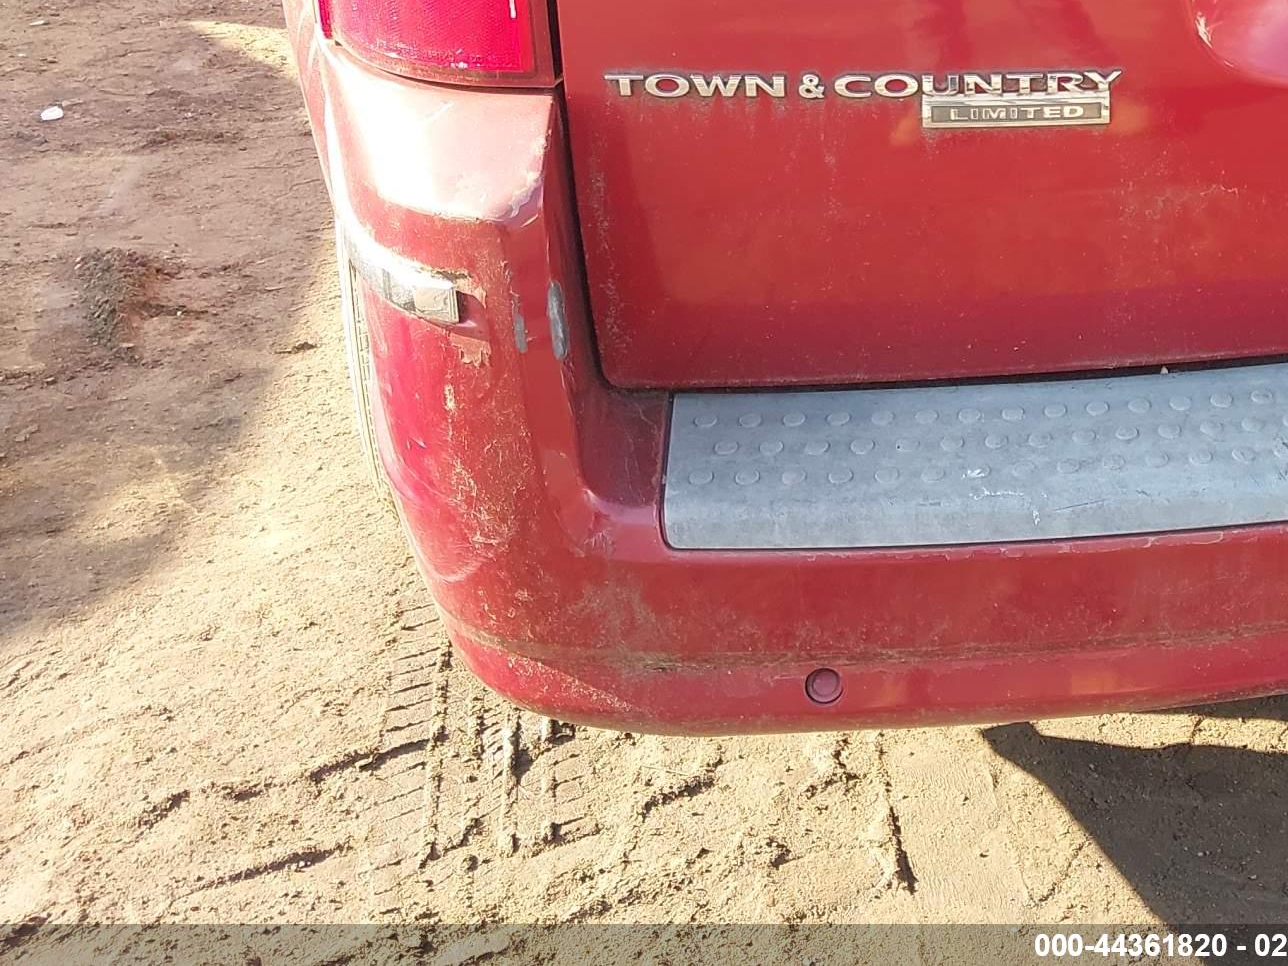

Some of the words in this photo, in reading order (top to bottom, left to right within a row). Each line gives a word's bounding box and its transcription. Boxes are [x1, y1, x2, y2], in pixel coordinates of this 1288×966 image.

[604, 73, 786, 98] TOWN
[798, 73, 825, 99] &
[834, 70, 1122, 98] COUNTRY
[950, 105, 1084, 121] LIMITED
